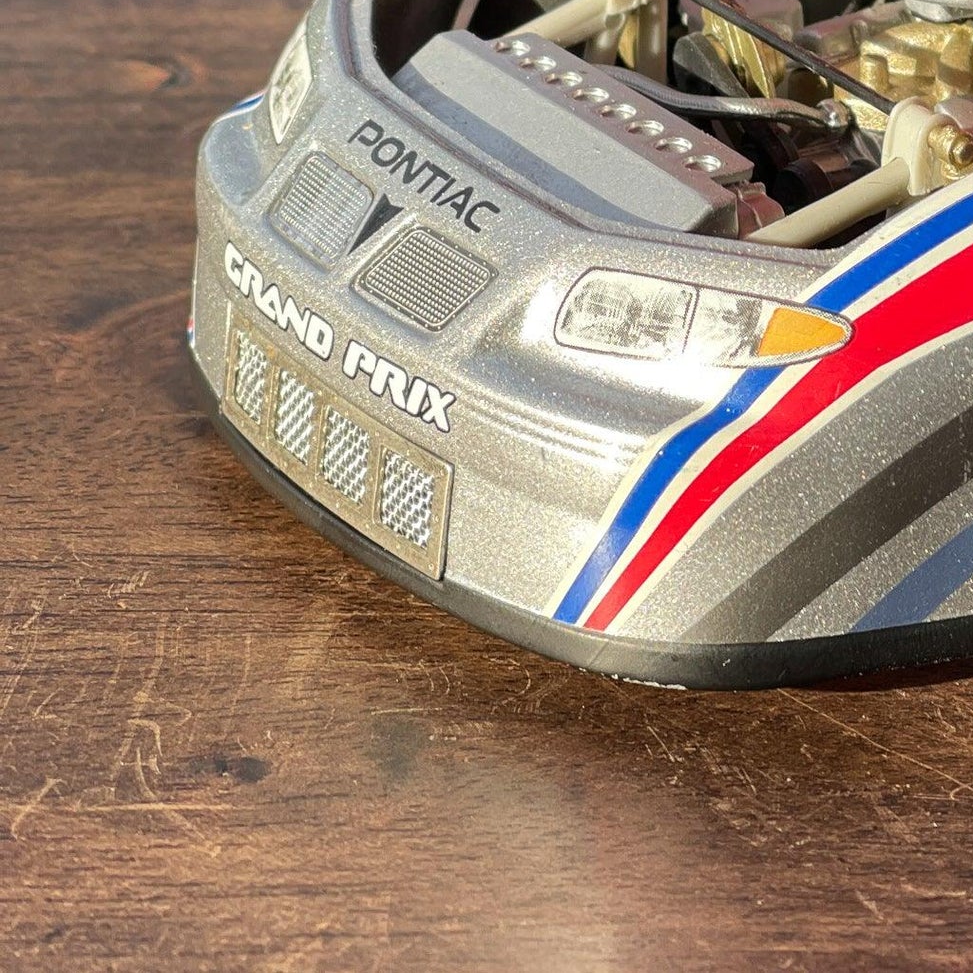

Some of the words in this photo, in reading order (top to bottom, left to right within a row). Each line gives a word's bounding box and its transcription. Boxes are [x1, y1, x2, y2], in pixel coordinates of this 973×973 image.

[348, 118, 500, 234] PONTIAC
[224, 240, 335, 361] GRAND
[342, 338, 457, 433] PRIX
